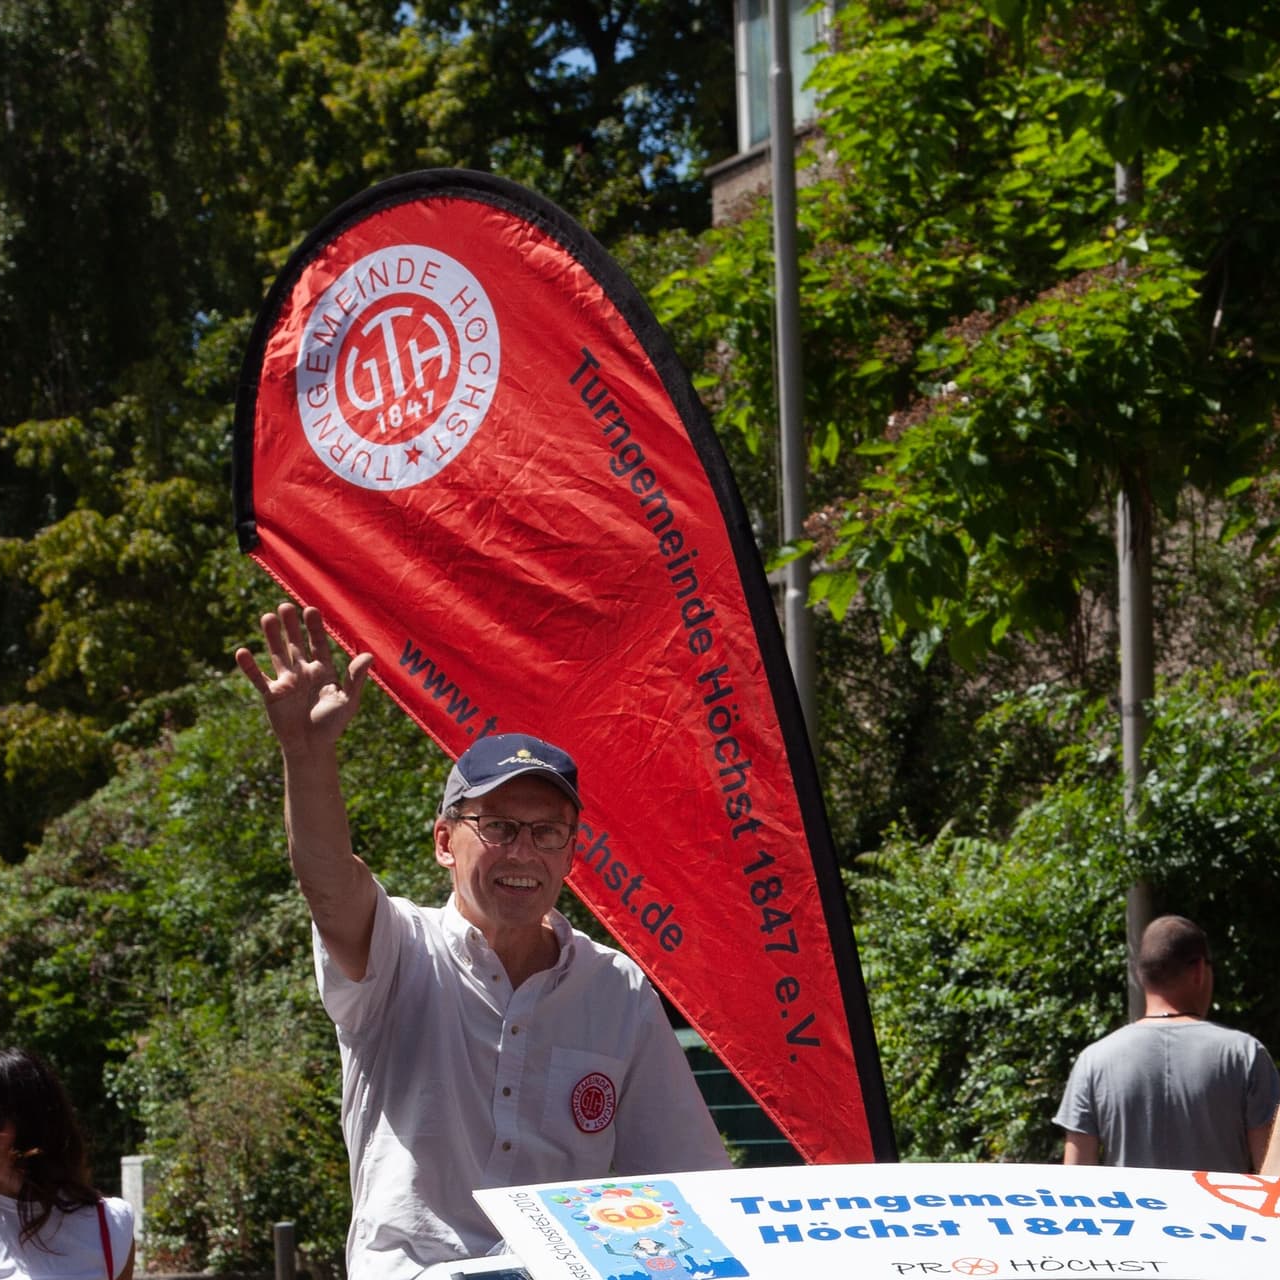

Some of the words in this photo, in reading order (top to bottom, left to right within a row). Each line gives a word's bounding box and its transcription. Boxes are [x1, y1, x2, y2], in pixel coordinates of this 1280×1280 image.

[305, 257, 441, 482] TURNGEMEINDE
[431, 285, 491, 462] HÖCHST
[376, 389, 435, 434] 1847
[568, 347, 715, 655] Turngemeinde
[697, 664, 763, 840] Höchst
[743, 850, 799, 954] 1847
[775, 975, 821, 1063] e.V.
[399, 638, 498, 740] www.t
[576, 823, 684, 952] chst.de
[507, 1192, 540, 1214] 2016
[730, 1188, 1169, 1216] Turngemeinde
[758, 1218, 961, 1245] Höchst
[987, 1217, 1137, 1237] 1847
[1162, 1222, 1268, 1242] e.V.
[1009, 1254, 1169, 1274] HÖCHST
